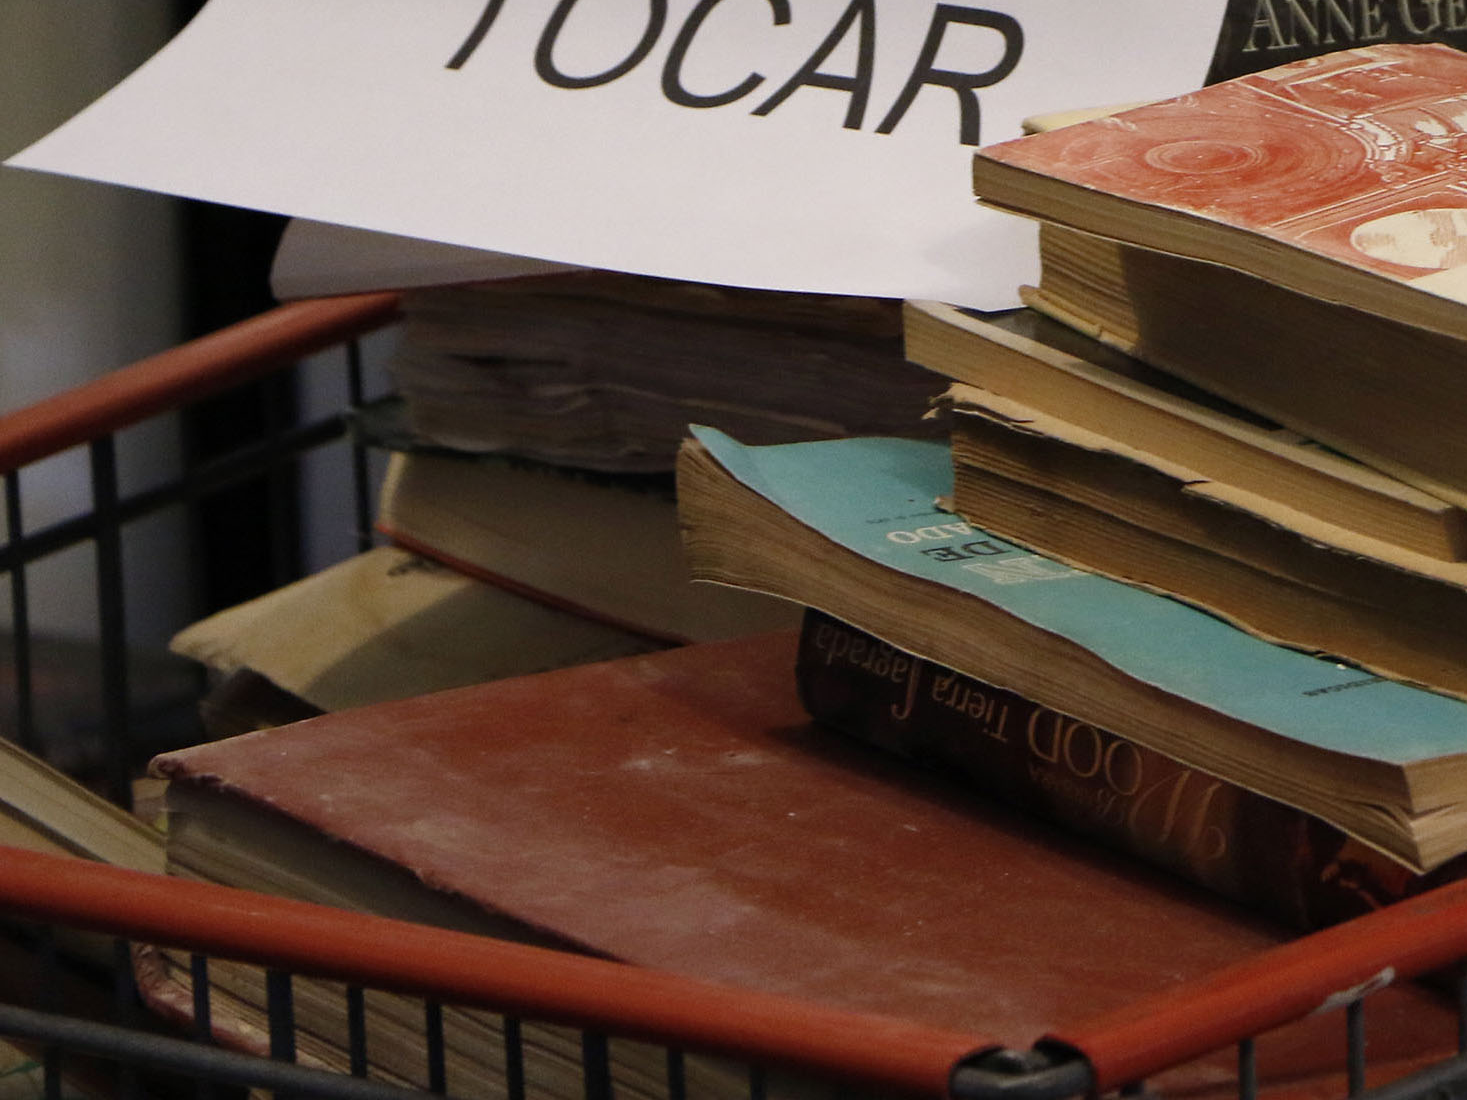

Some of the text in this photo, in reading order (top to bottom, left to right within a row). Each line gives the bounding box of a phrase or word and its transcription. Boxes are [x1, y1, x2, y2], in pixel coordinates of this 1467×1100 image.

[920, 540, 1012, 563] DE
[931, 670, 1009, 743] Tierra
[1026, 707, 1228, 860] WOOD
